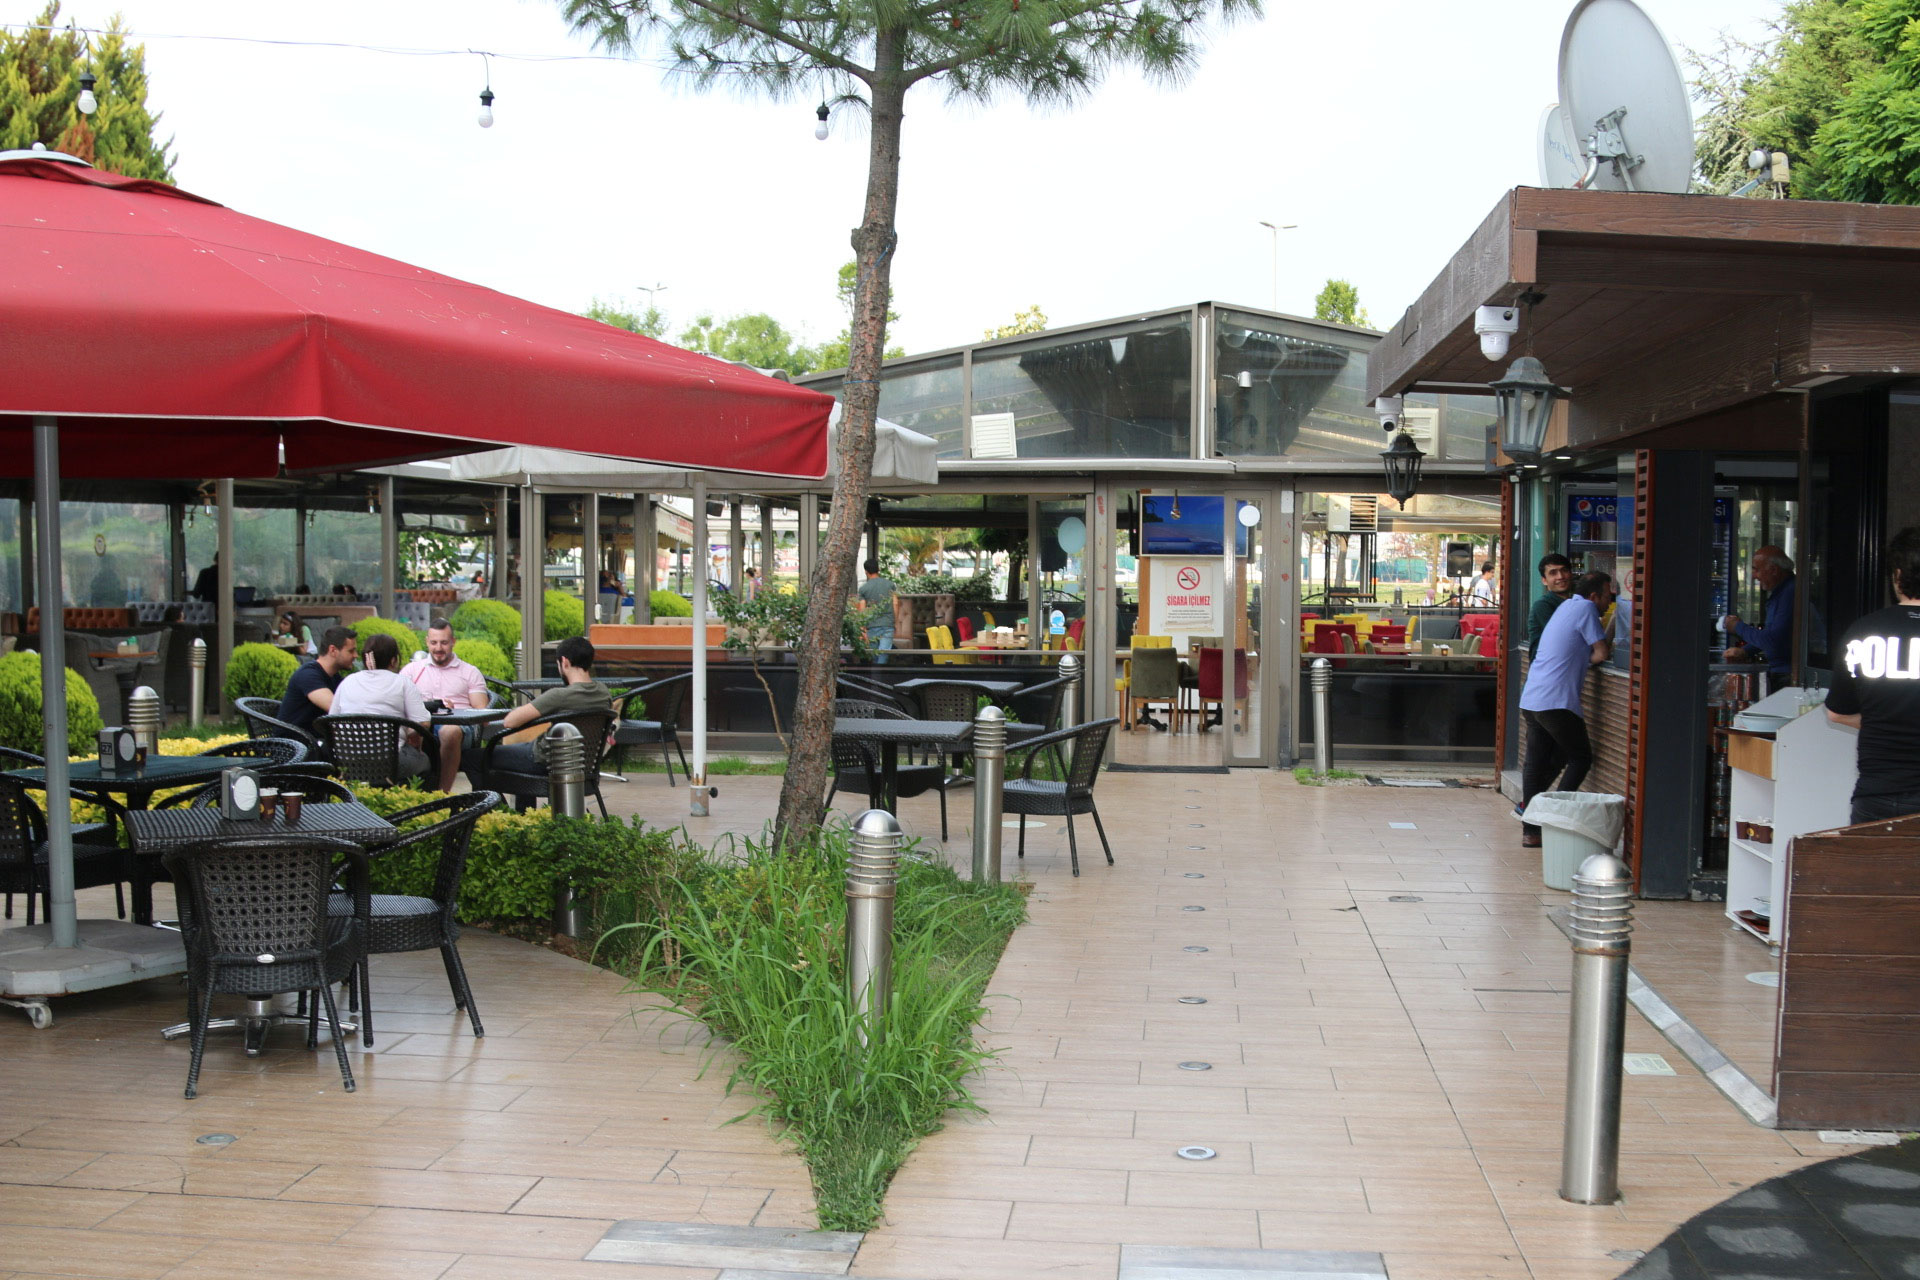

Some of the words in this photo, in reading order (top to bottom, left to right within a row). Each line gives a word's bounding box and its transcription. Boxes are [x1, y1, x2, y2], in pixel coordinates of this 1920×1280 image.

[1596, 504, 1616, 517] pe
[1715, 505, 1726, 516] si
[1844, 635, 1920, 679] POLI
